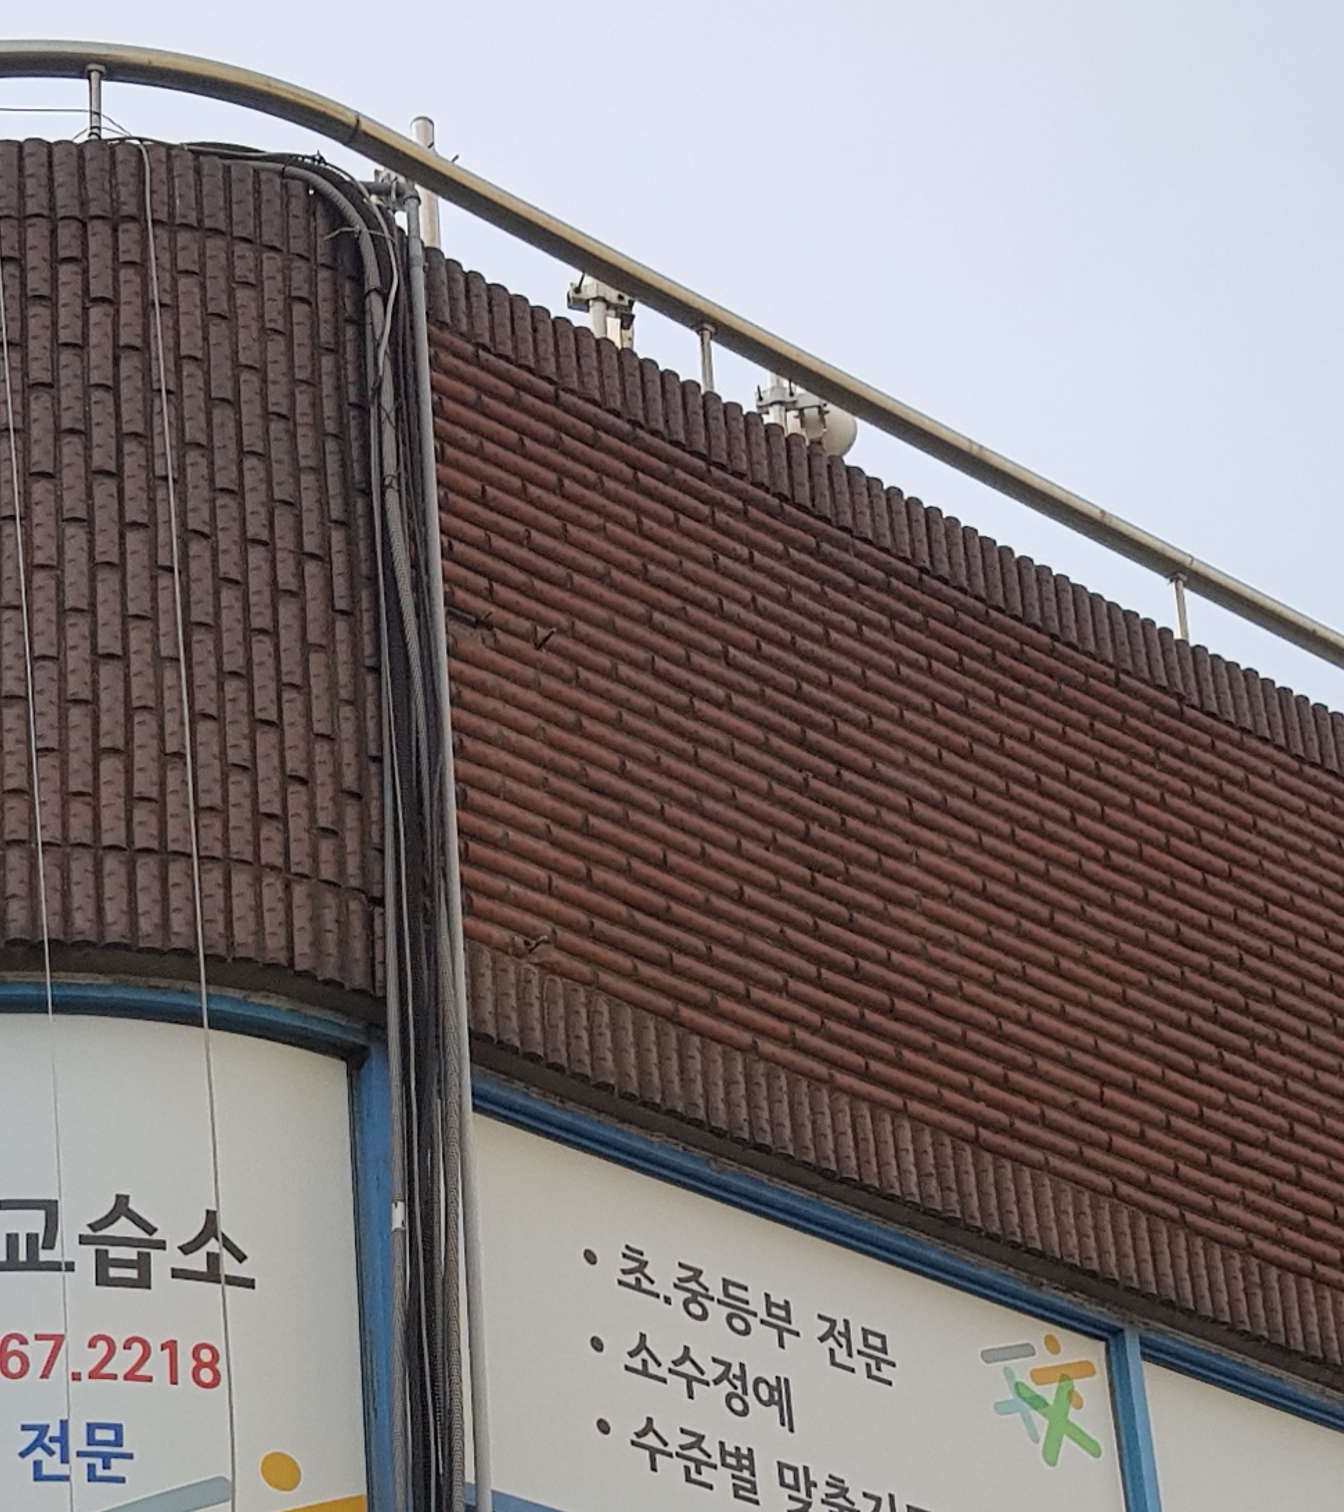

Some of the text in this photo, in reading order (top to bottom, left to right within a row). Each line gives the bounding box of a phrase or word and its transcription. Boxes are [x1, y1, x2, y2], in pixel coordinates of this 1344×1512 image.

[624, 1331, 796, 1433] 소수정예
[816, 1311, 898, 1388] 전문
[17, 1419, 136, 1487] 전문
[630, 1415, 762, 1507] 수준별
